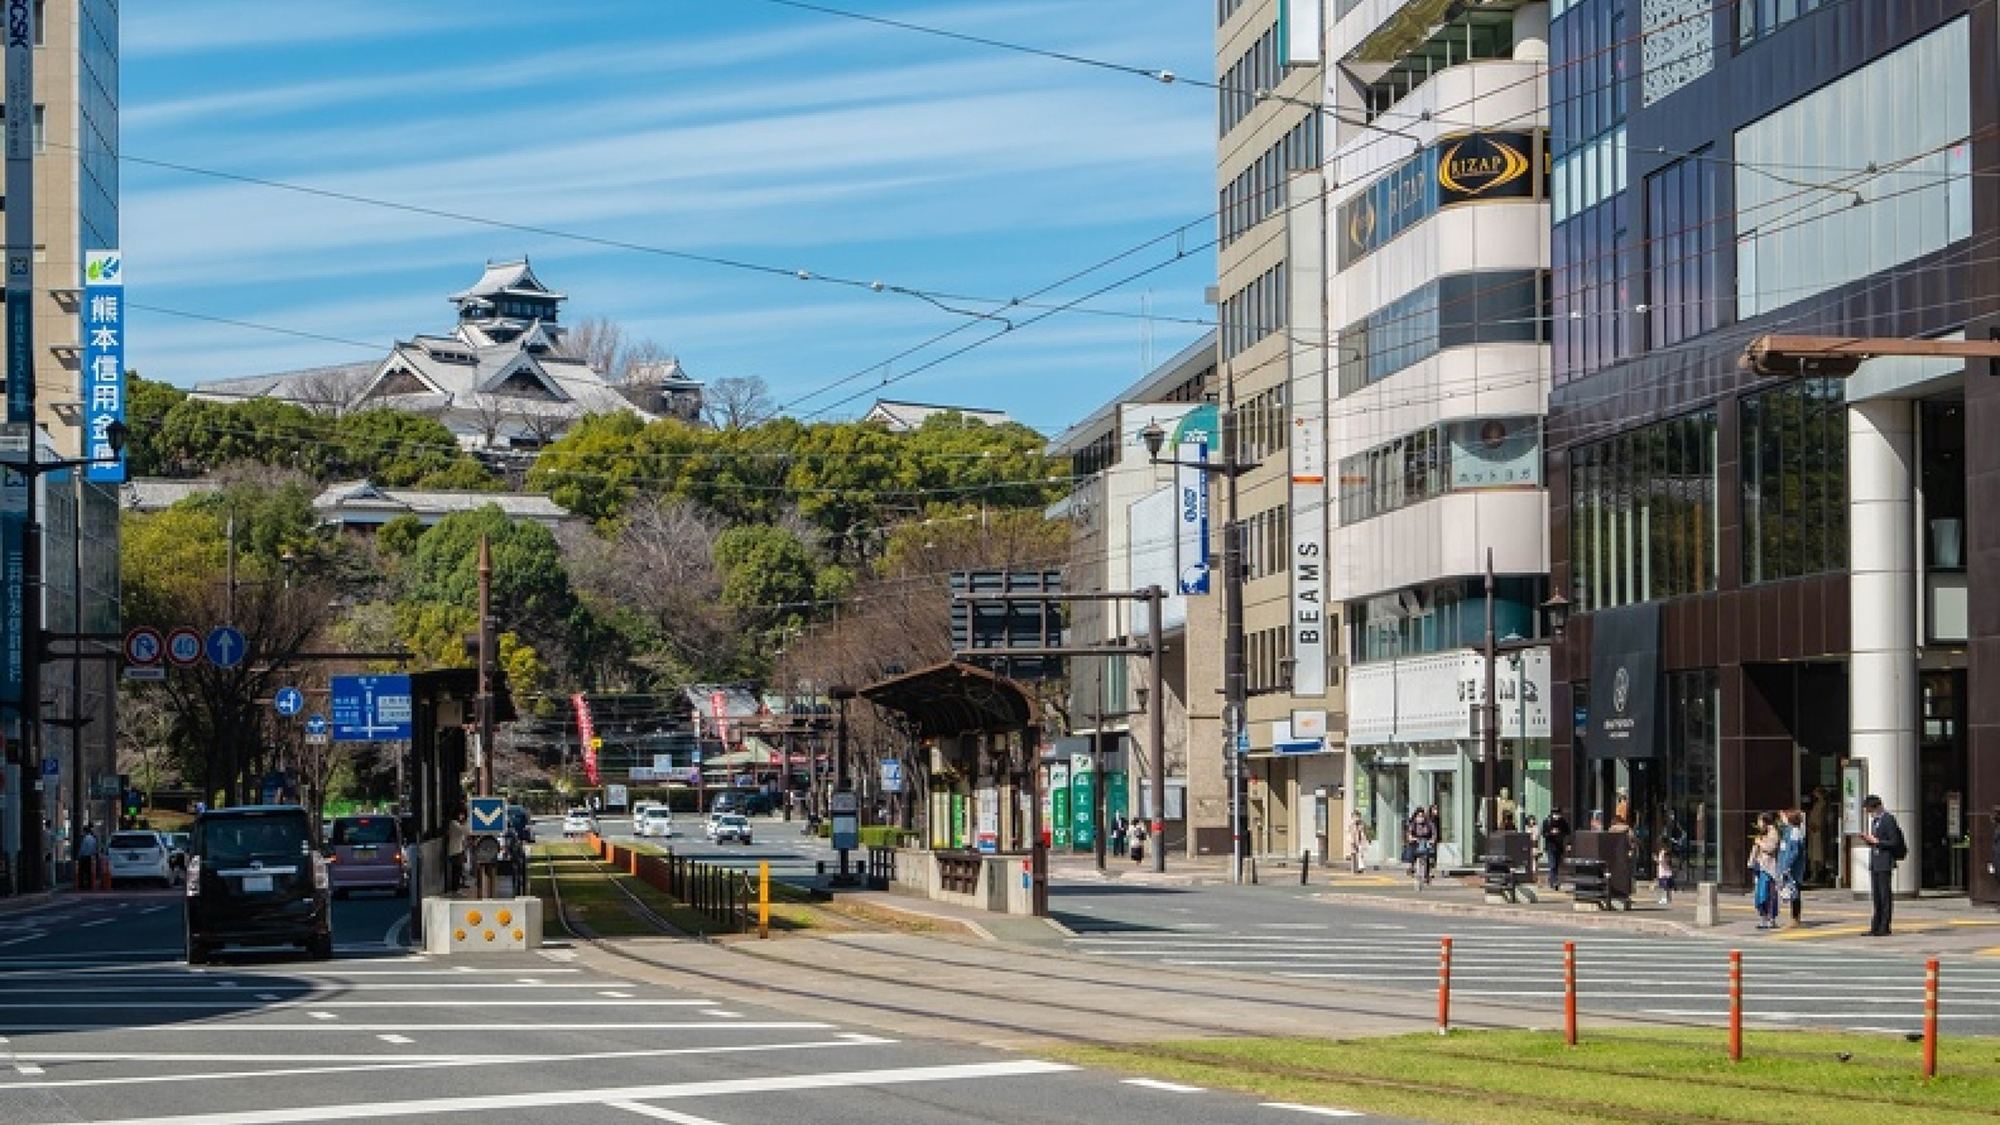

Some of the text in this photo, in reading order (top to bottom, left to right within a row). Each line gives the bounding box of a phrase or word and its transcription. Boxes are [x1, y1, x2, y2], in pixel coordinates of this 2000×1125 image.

[1451, 155, 1501, 176] RIZAP
[1298, 542, 1318, 644] BEAMS
[175, 638, 196, 656] 40
